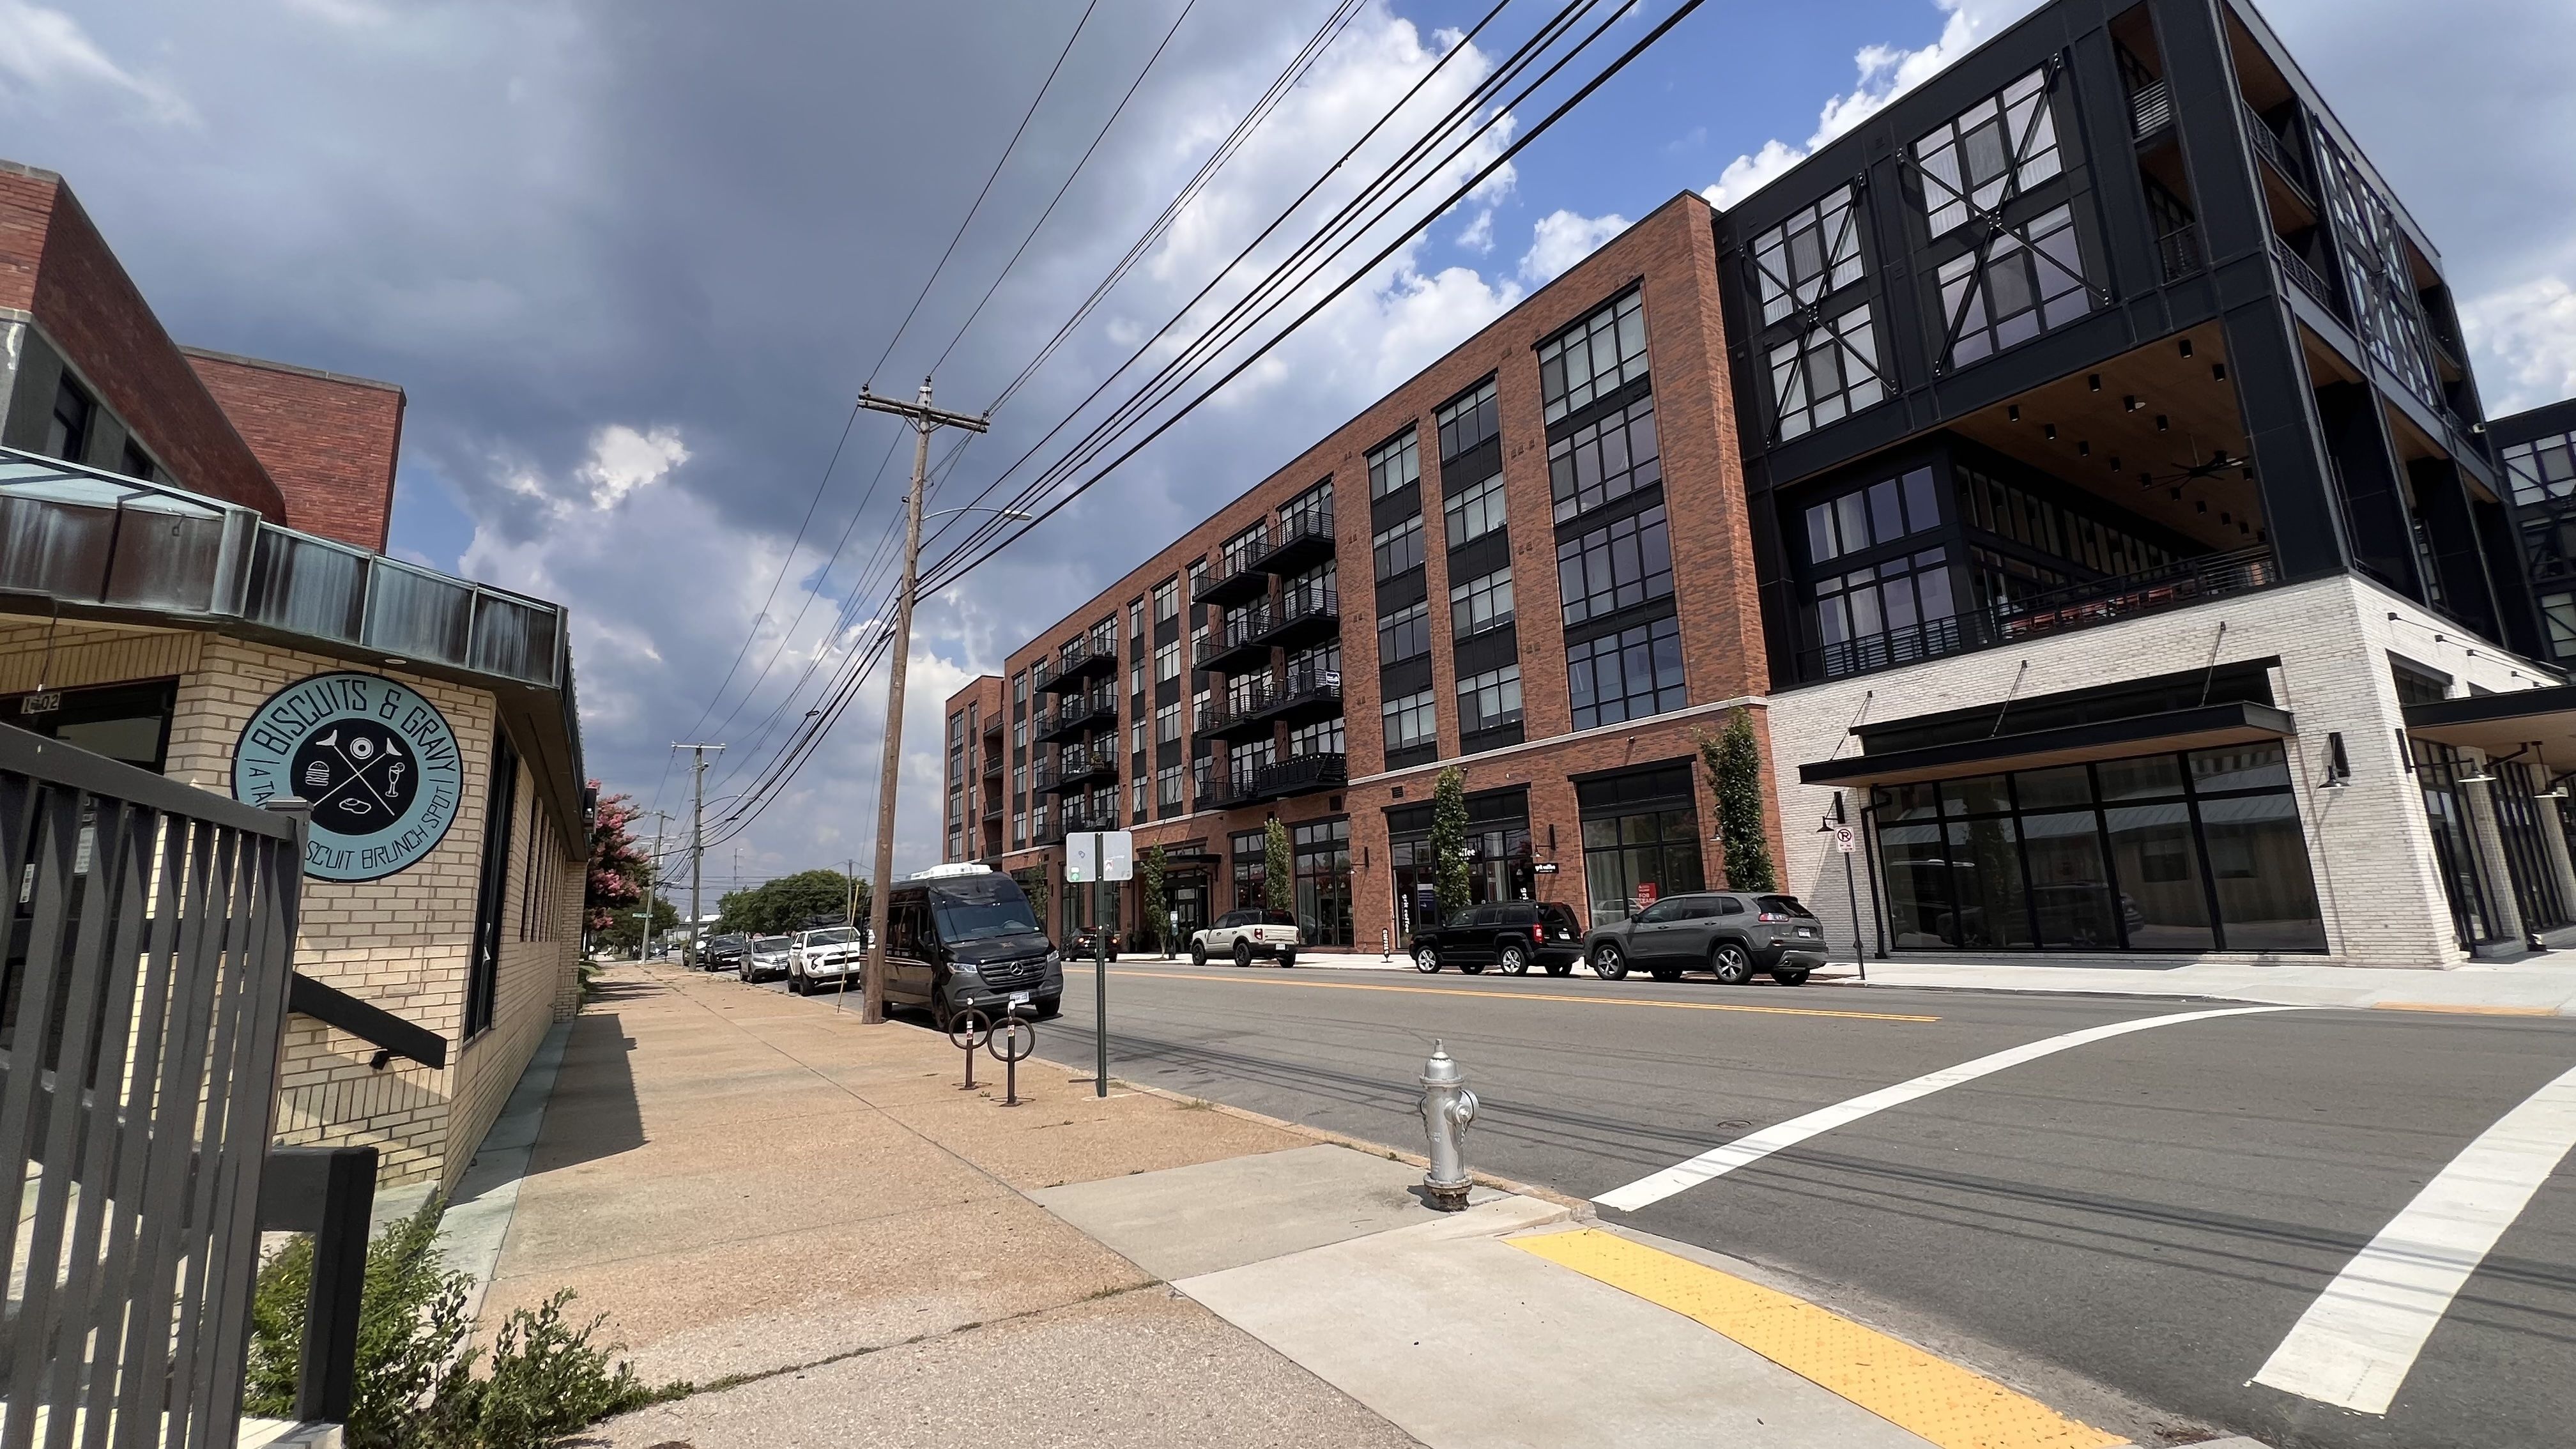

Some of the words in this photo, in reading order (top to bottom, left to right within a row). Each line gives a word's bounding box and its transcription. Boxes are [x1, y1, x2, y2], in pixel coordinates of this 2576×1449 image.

[251, 679, 367, 756] BISCUITS
[379, 689, 401, 720] &
[400, 706, 456, 772] GRAVY
[305, 840, 355, 870] SCUIT
[362, 824, 429, 869] BRUNCH
[421, 786, 453, 829] SPOT
